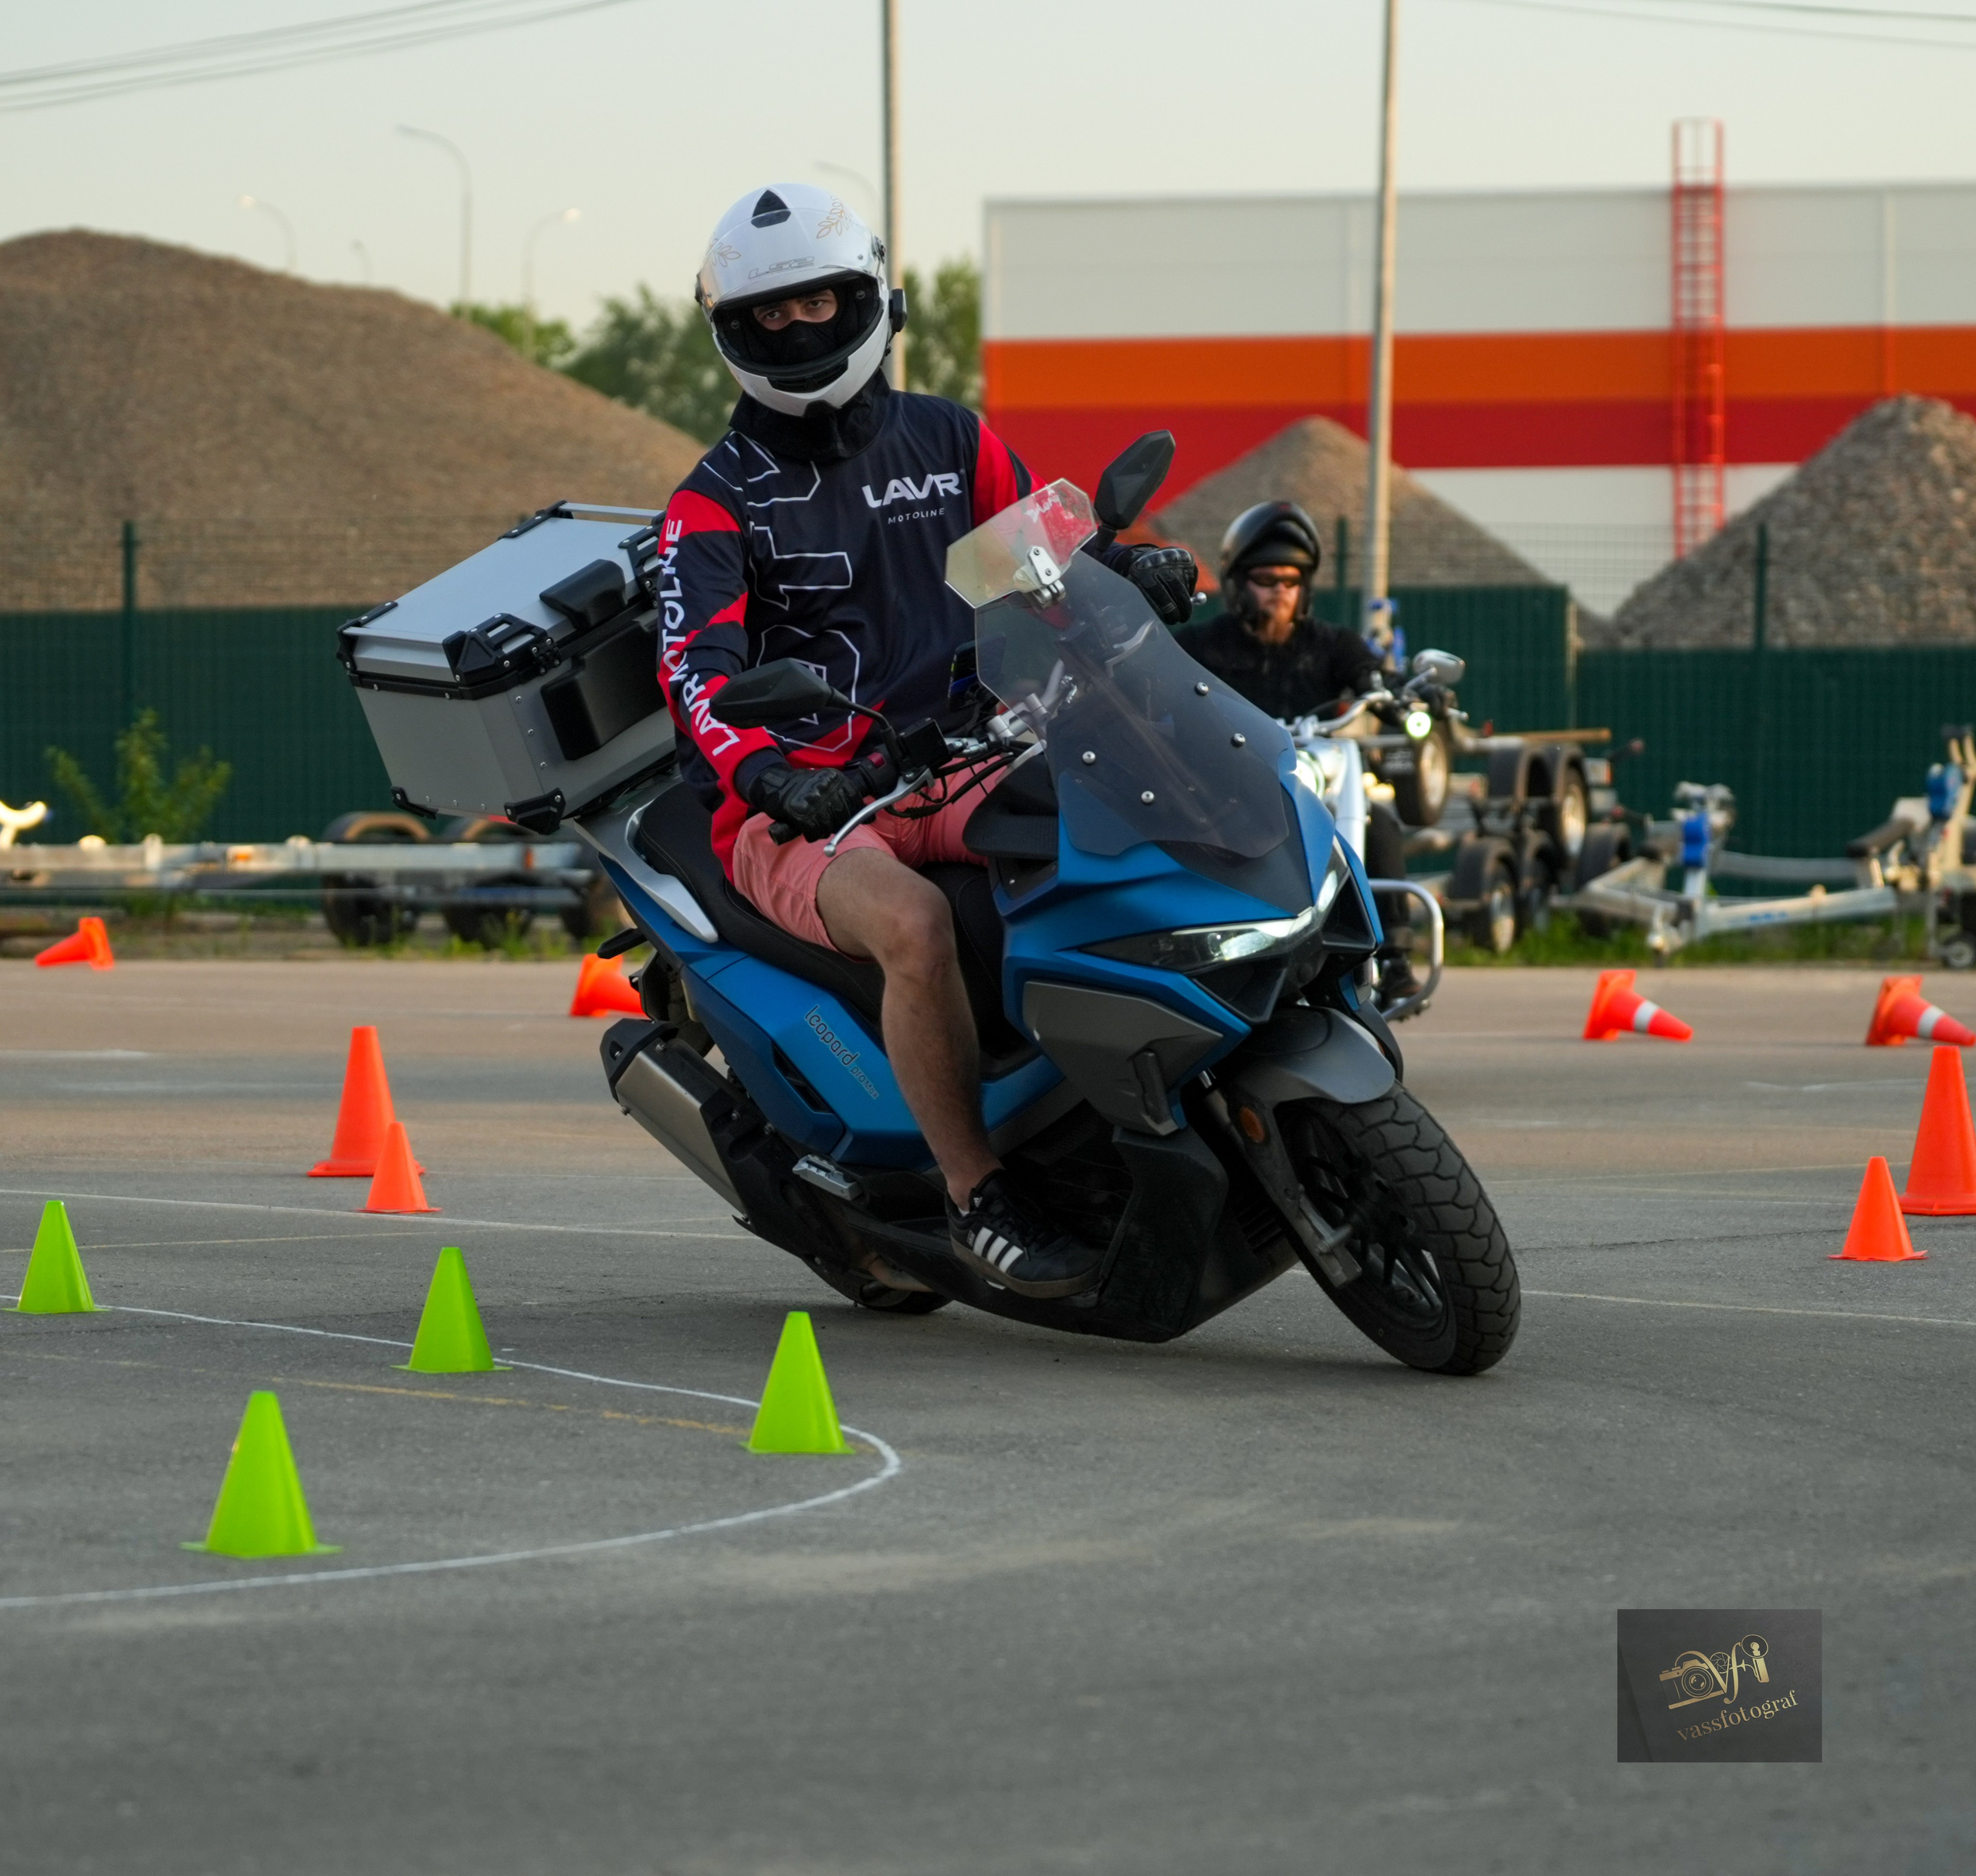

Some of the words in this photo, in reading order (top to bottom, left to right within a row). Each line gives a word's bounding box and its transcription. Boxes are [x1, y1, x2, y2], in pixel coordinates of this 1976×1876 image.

[861, 472, 963, 509] LAVR
[888, 508, 946, 524] MOTOLINE
[682, 673, 740, 756] LAVR
